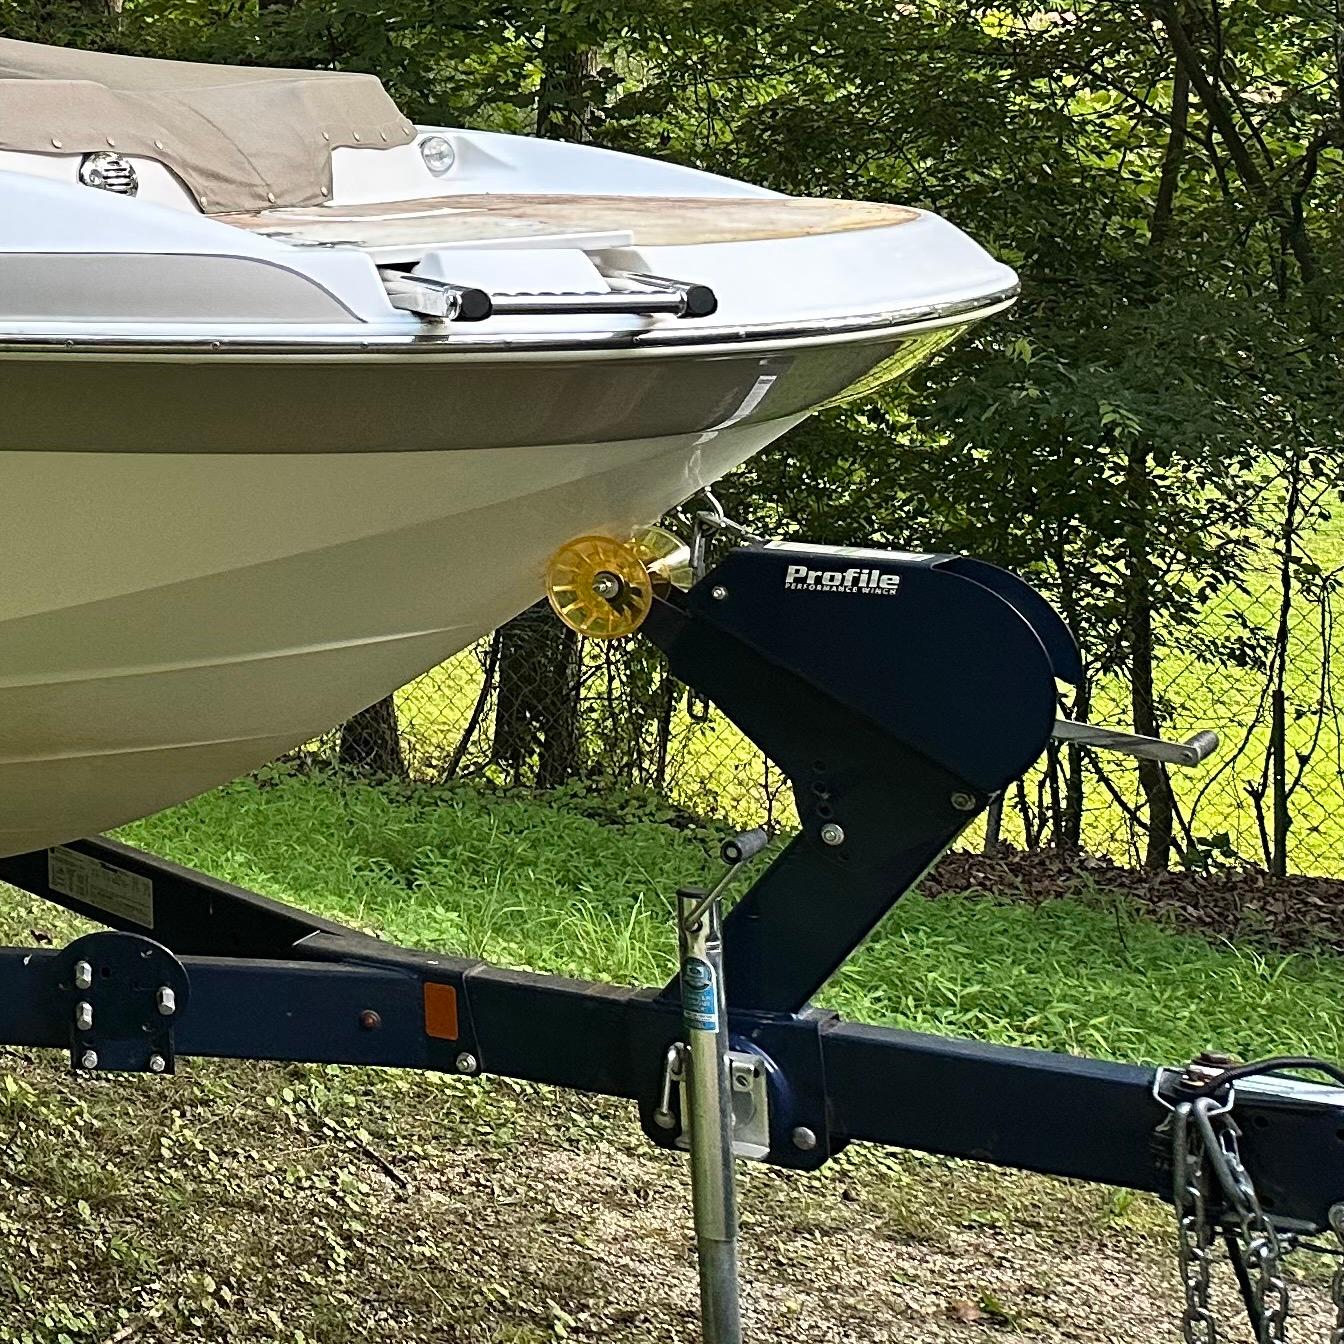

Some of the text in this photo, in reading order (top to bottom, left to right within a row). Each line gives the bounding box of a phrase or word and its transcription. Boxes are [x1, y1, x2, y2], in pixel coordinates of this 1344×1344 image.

[785, 565, 900, 588] Profile
[785, 582, 897, 595] PERFORMANCE WINCH
